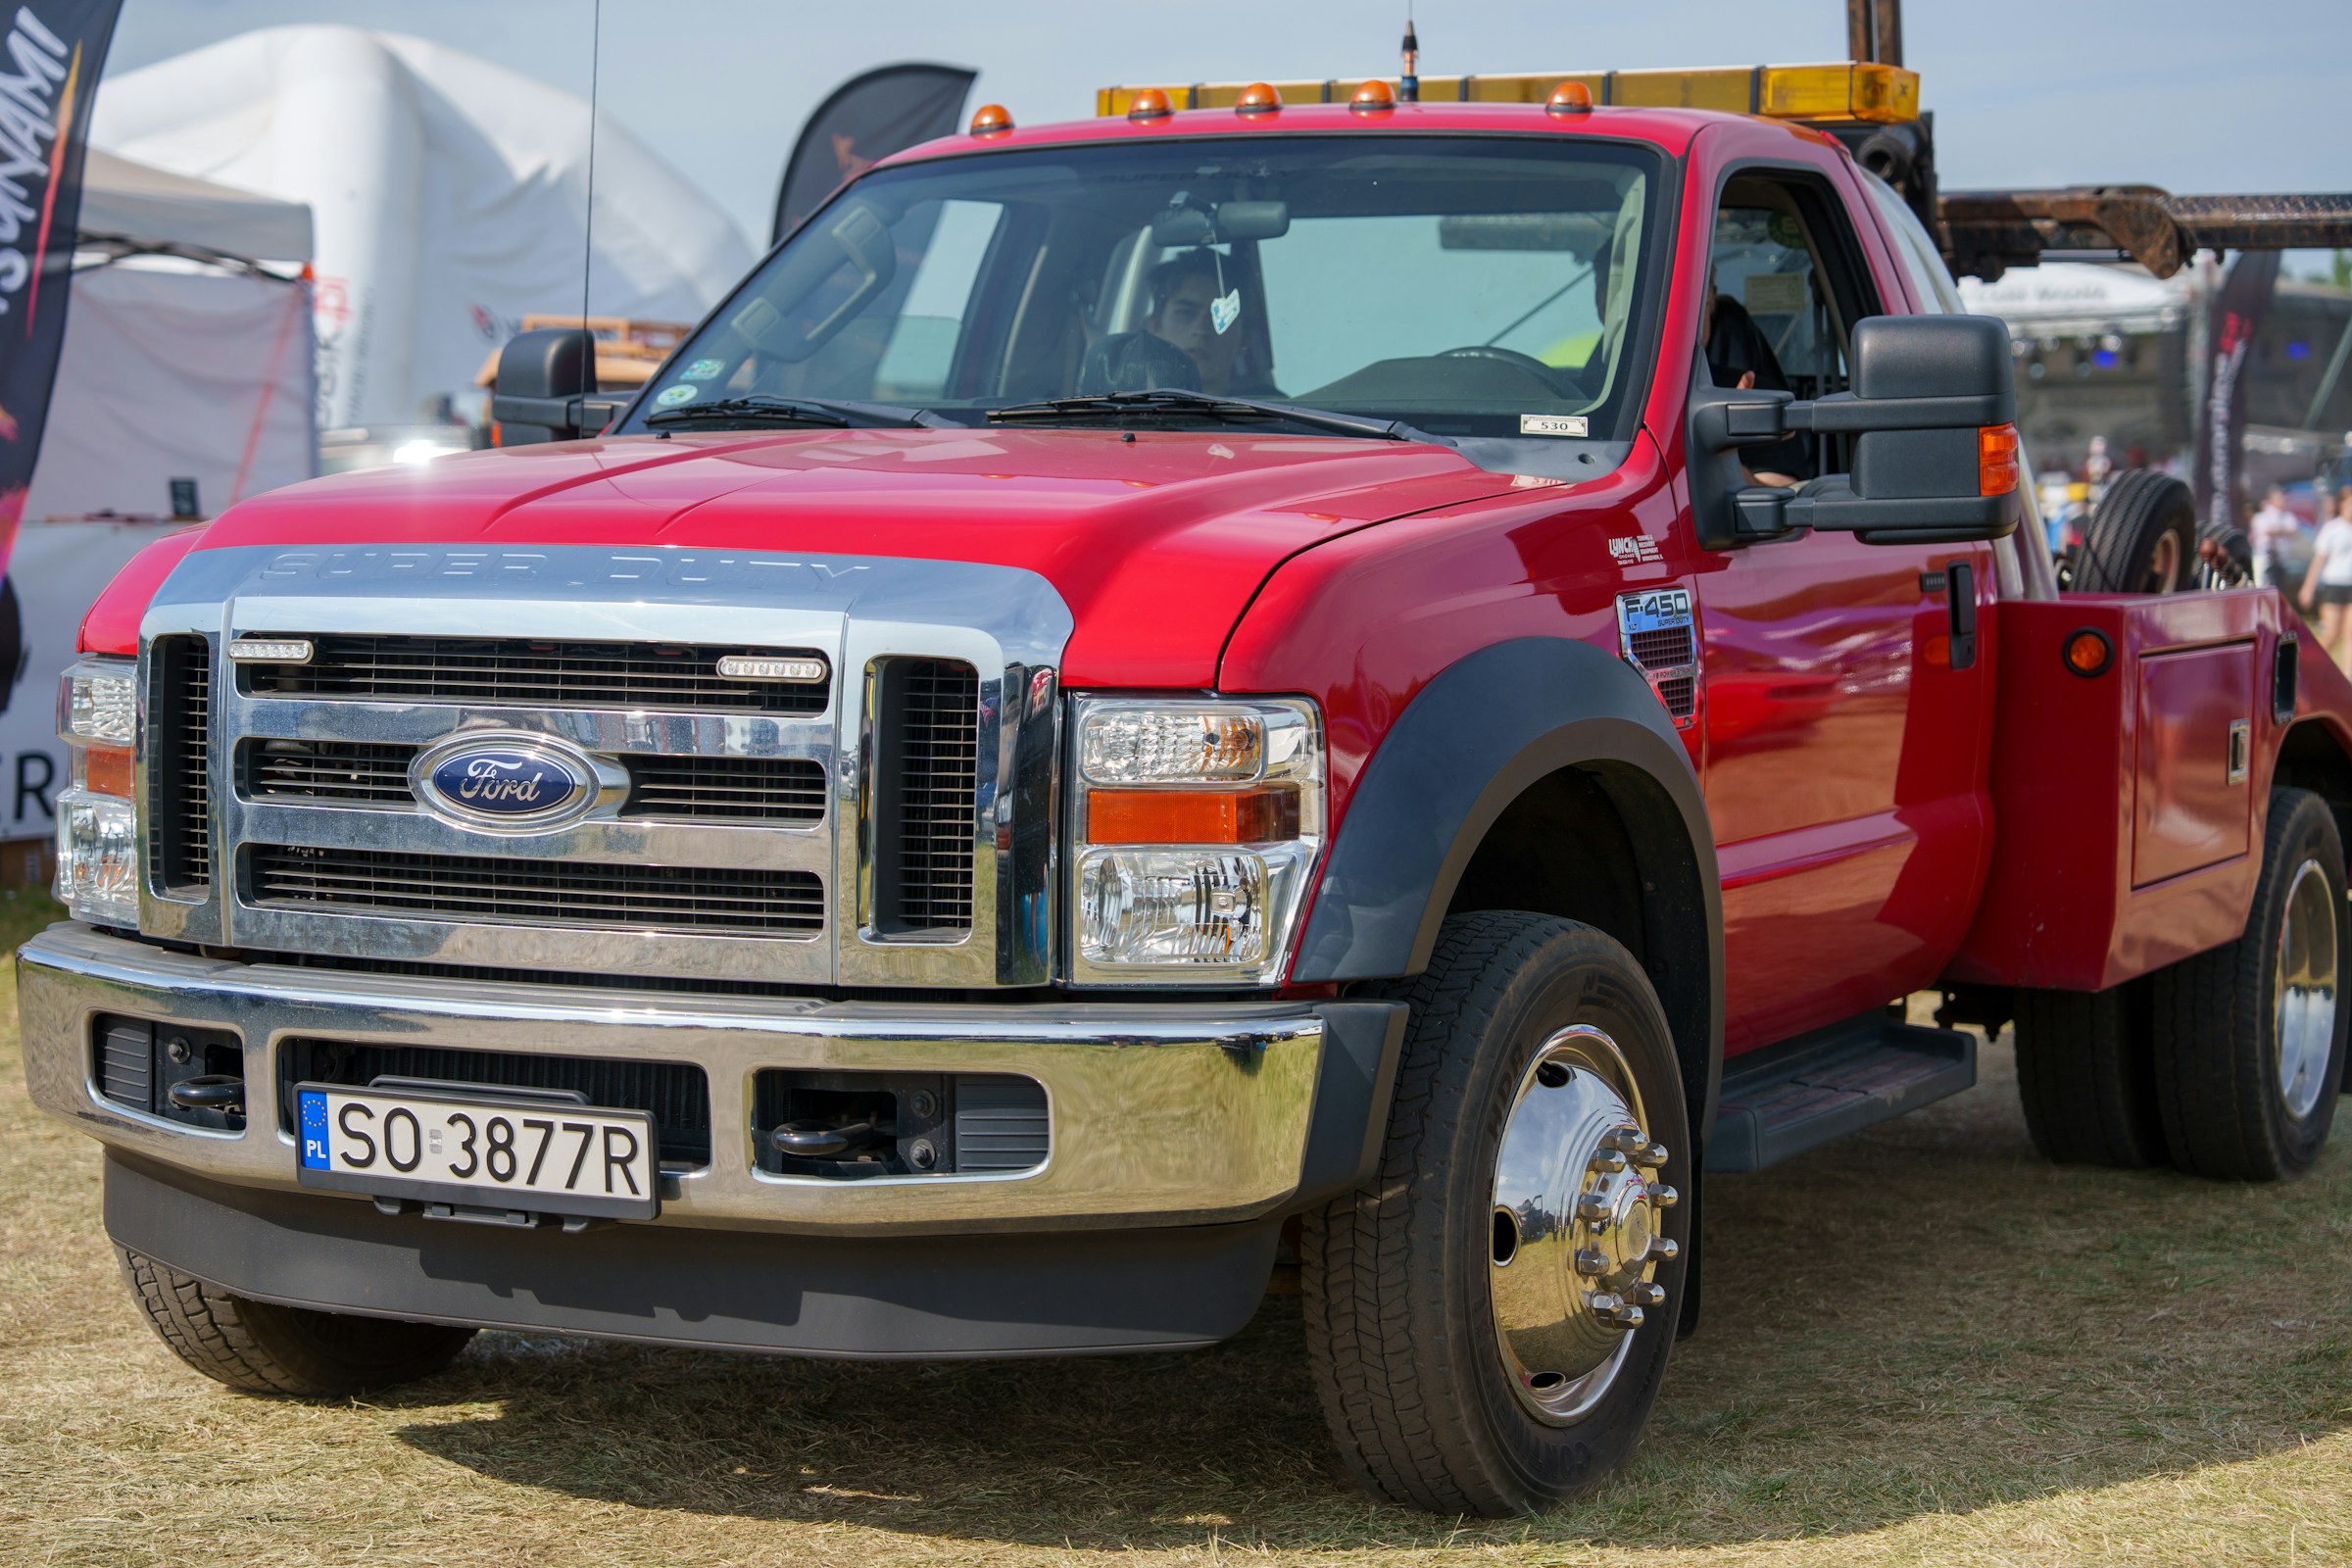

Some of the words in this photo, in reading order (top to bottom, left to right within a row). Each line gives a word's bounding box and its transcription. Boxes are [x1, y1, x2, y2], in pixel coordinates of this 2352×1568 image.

[1541, 421, 1568, 431] 530
[1608, 536, 1634, 558] LYNCH
[260, 553, 547, 580] SUPER
[592, 556, 871, 592] DUTY
[1625, 593, 1689, 622] F-450
[1657, 617, 1675, 627] SUPER
[1676, 615, 1690, 624] DUTY
[459, 759, 543, 802] Ford
[307, 1139, 326, 1159] PL
[338, 1102, 421, 1173] SO
[447, 1112, 641, 1195] 3877R
